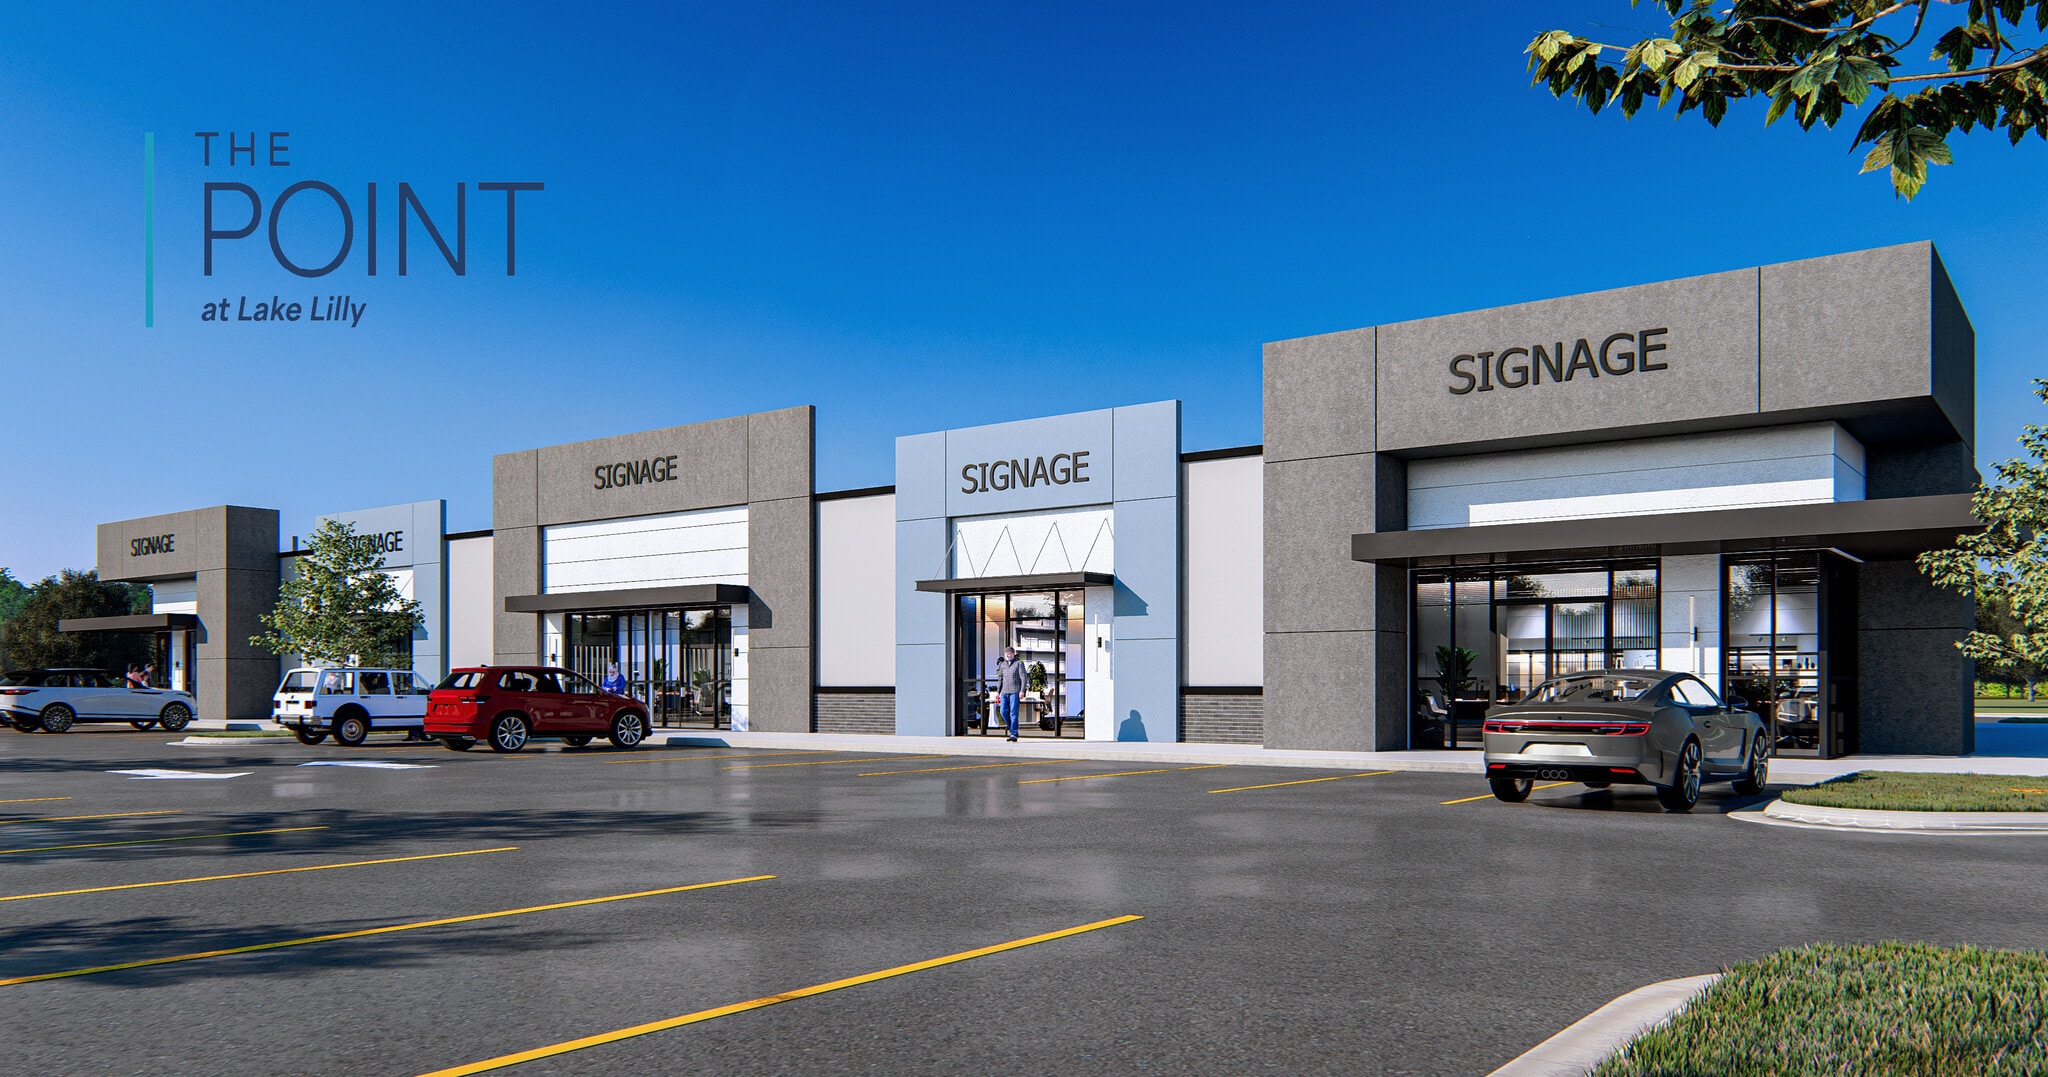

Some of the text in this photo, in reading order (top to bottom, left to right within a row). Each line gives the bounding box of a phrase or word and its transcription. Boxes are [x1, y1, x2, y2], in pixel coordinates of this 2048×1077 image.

[1449, 327, 1669, 395] SIGNAGE
[594, 455, 678, 490] SIGNAGE
[961, 451, 1090, 494] SIGNAGE
[130, 533, 175, 557] SIGNAGE
[346, 531, 403, 556] IGNAGE
